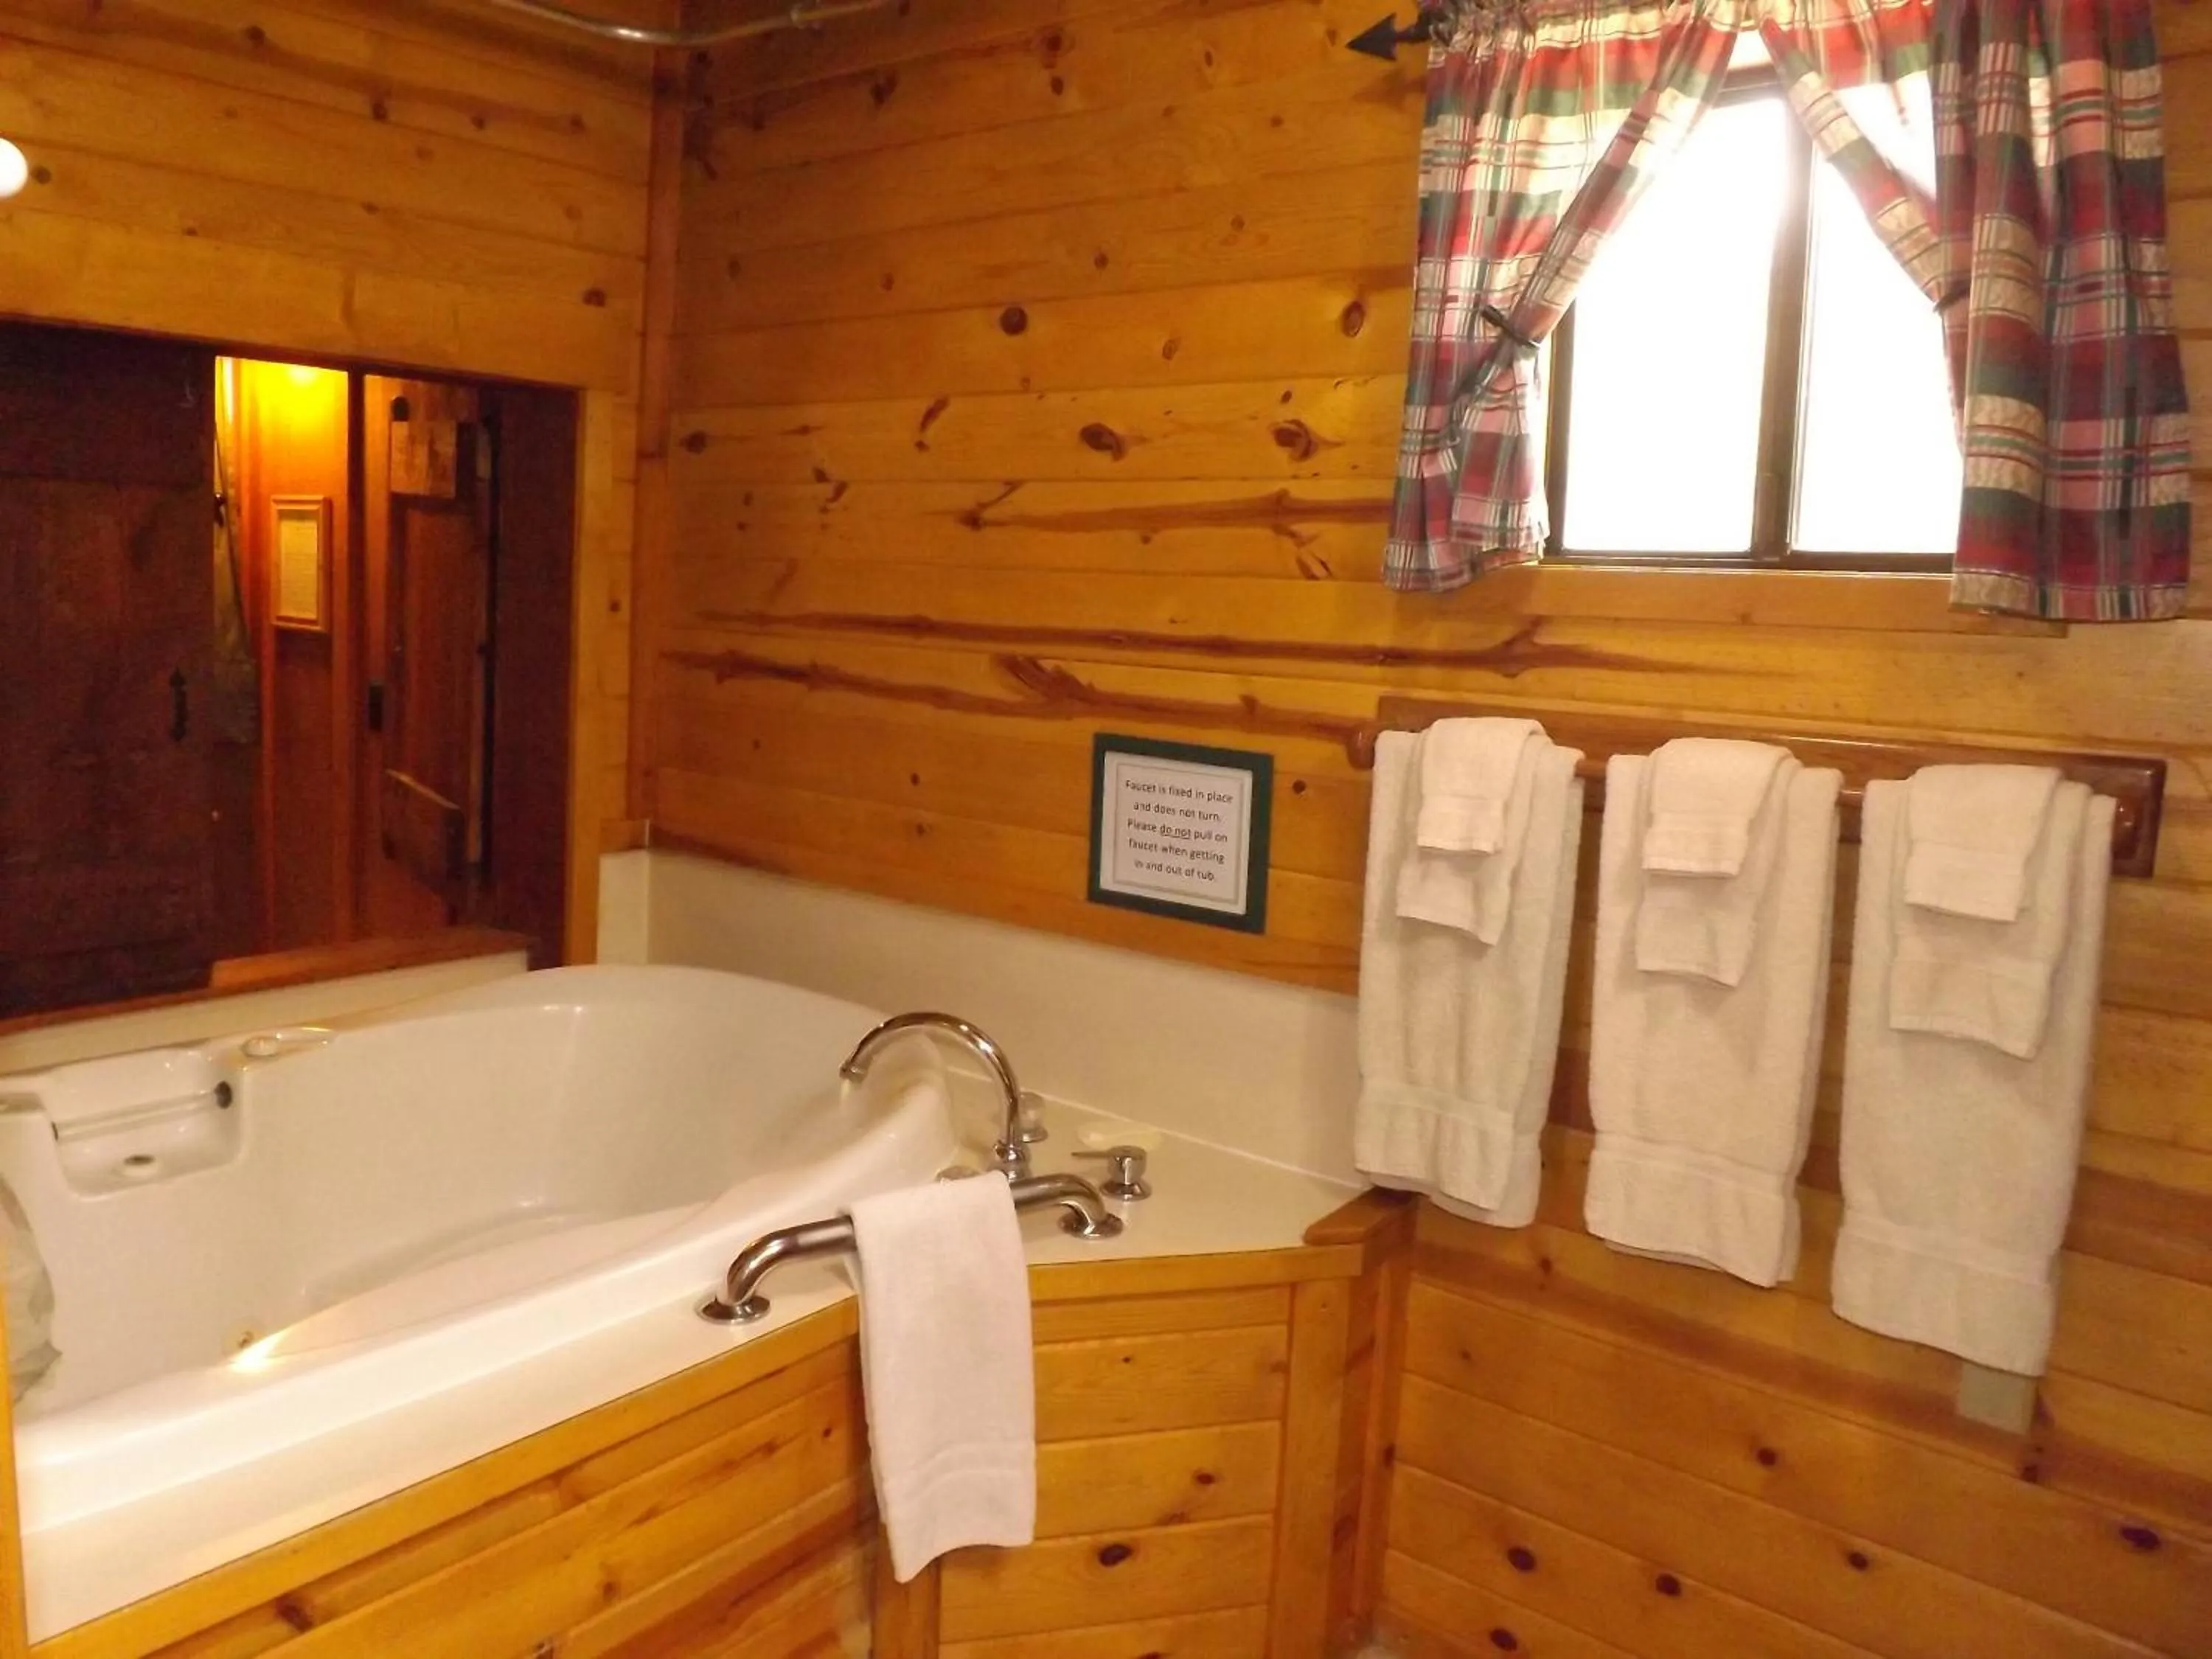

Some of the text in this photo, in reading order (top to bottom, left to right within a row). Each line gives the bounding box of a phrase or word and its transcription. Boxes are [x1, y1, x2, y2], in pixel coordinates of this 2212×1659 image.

[1126, 779, 1234, 804] Faucet is fixed in place
[1133, 801, 1151, 811] and
[1154, 804, 1176, 815] does
[1179, 808, 1195, 818] not
[1127, 818, 1228, 843] Please do not pull on
[1129, 838, 1225, 864] faucet when getting
[1135, 859, 1143, 868] in
[1146, 861, 1163, 872] and
[1166, 866, 1182, 877] out
[1185, 868, 1195, 877] of
